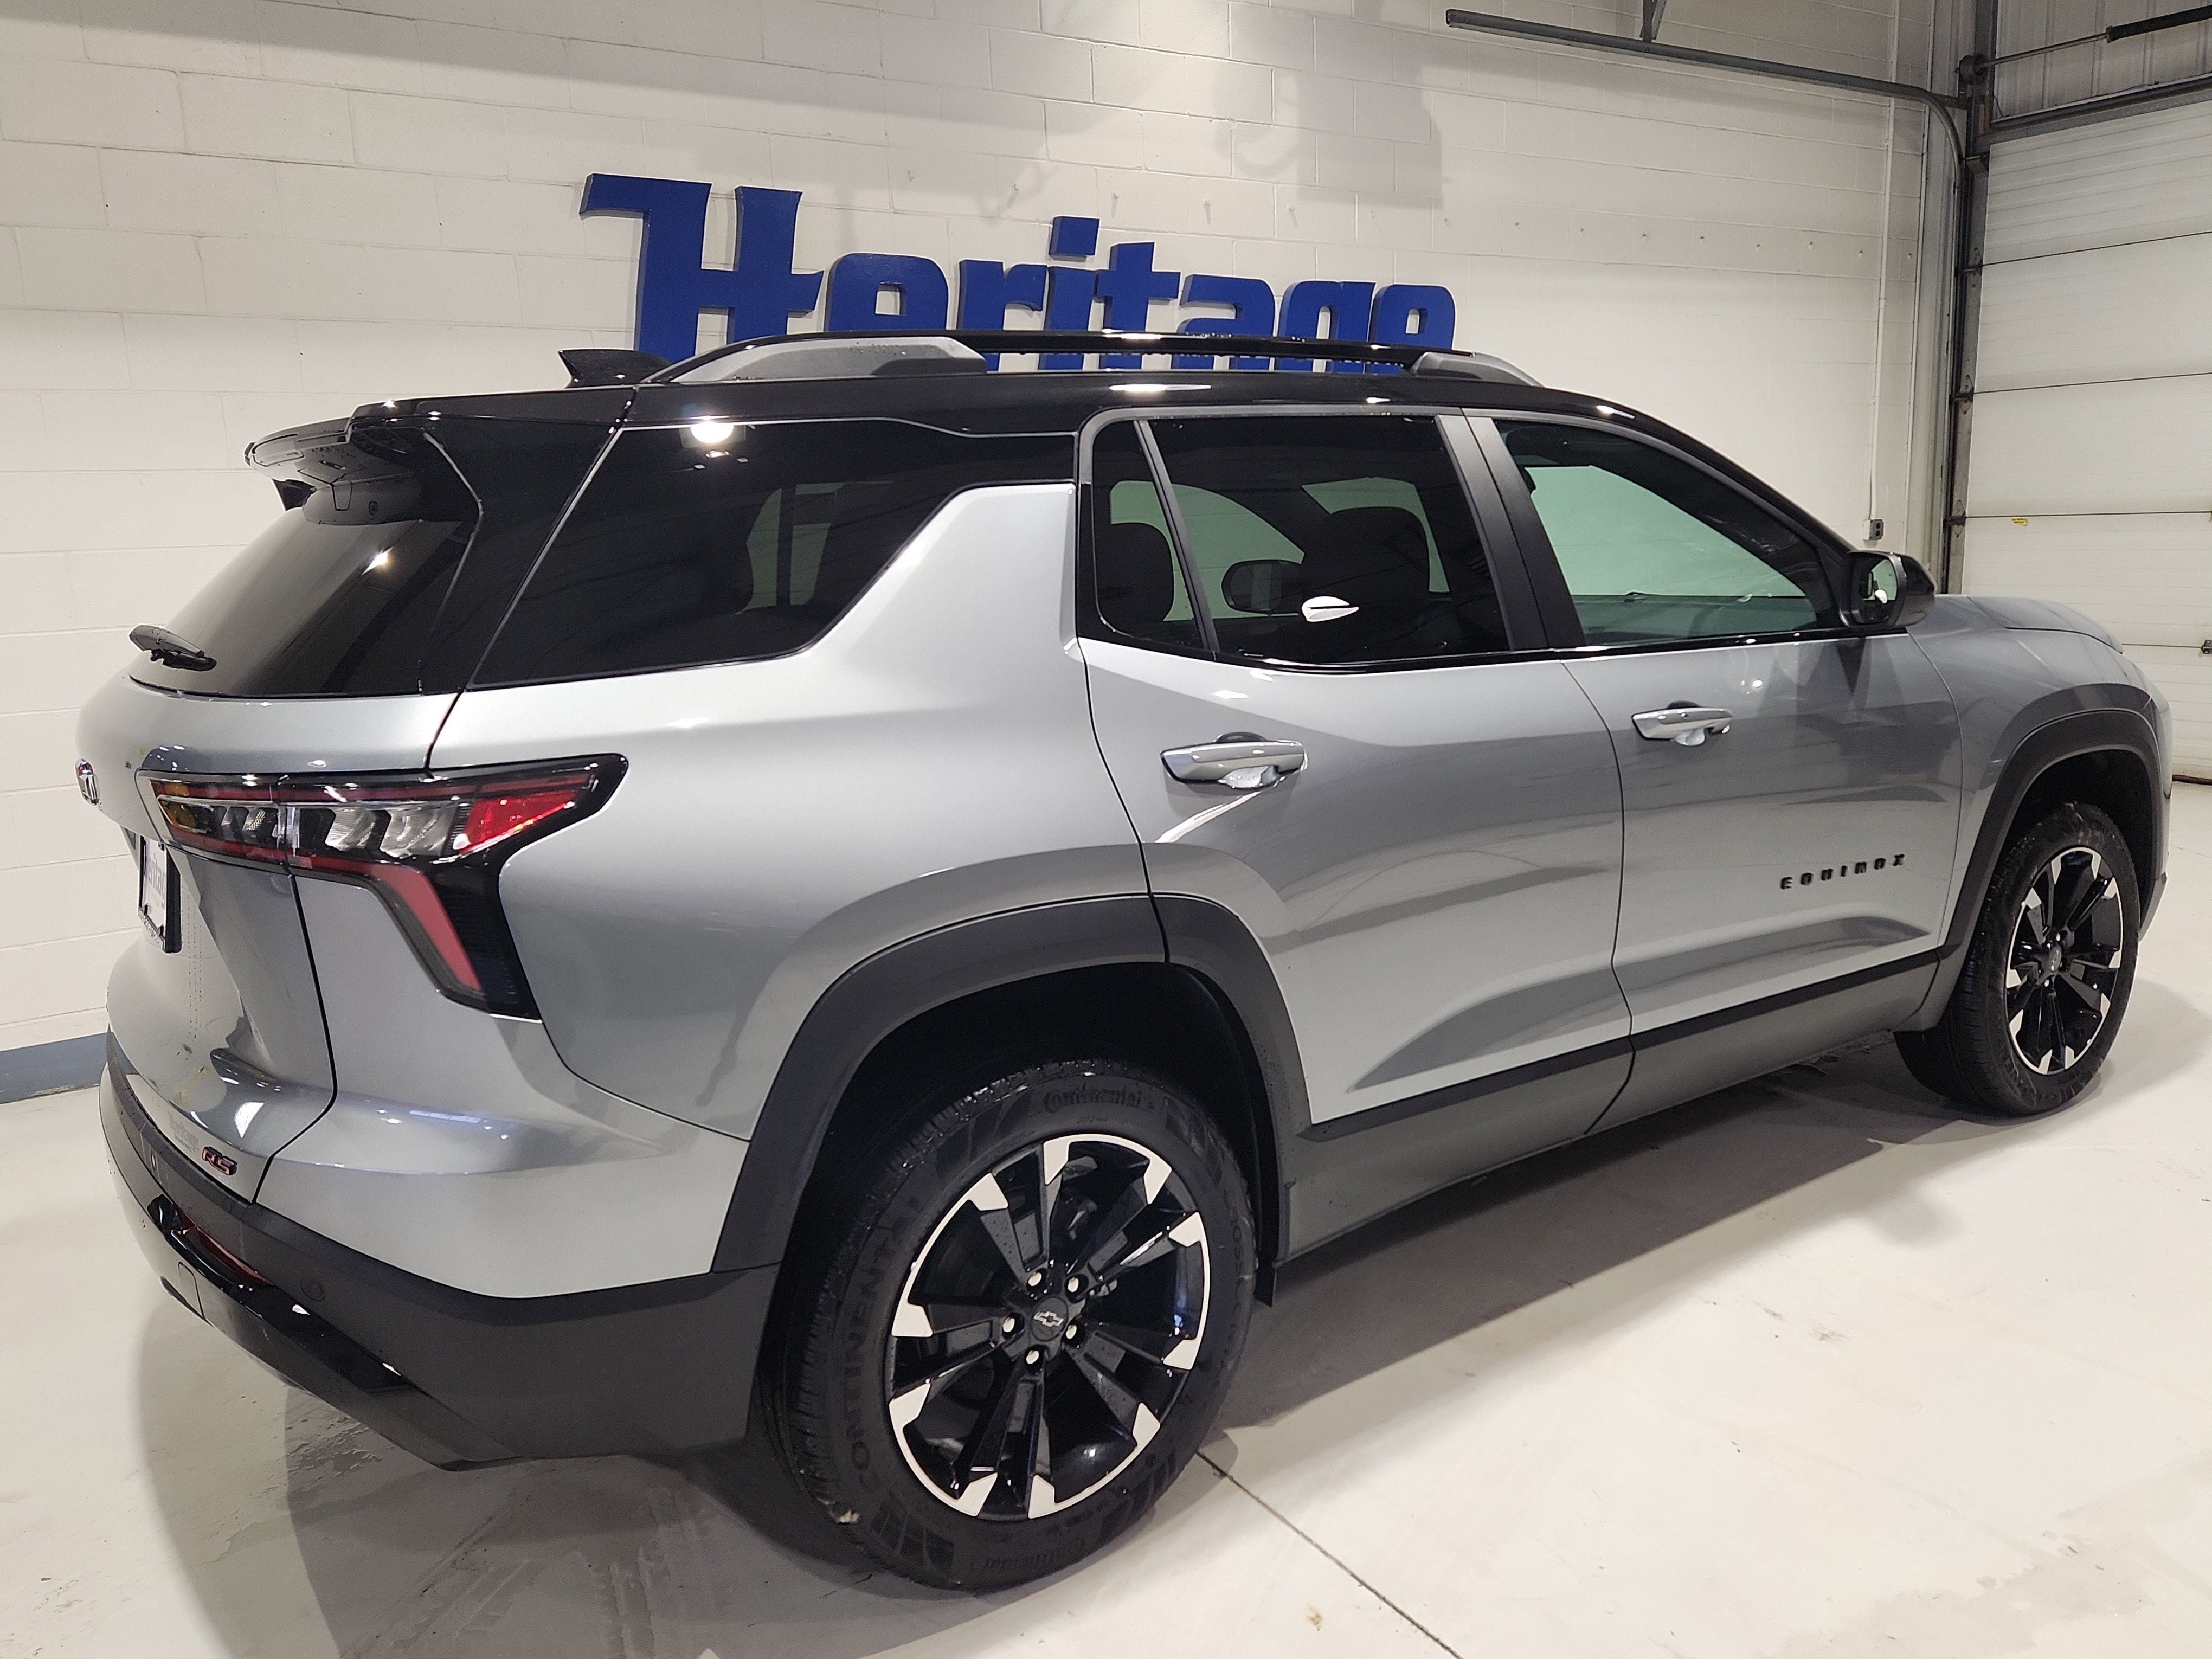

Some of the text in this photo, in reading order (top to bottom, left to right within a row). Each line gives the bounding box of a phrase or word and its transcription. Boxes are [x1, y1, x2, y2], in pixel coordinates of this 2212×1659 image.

[578, 172, 1457, 374] Heritage
[1780, 853, 1905, 890] EQUINOX
[202, 1146, 238, 1176] RS
